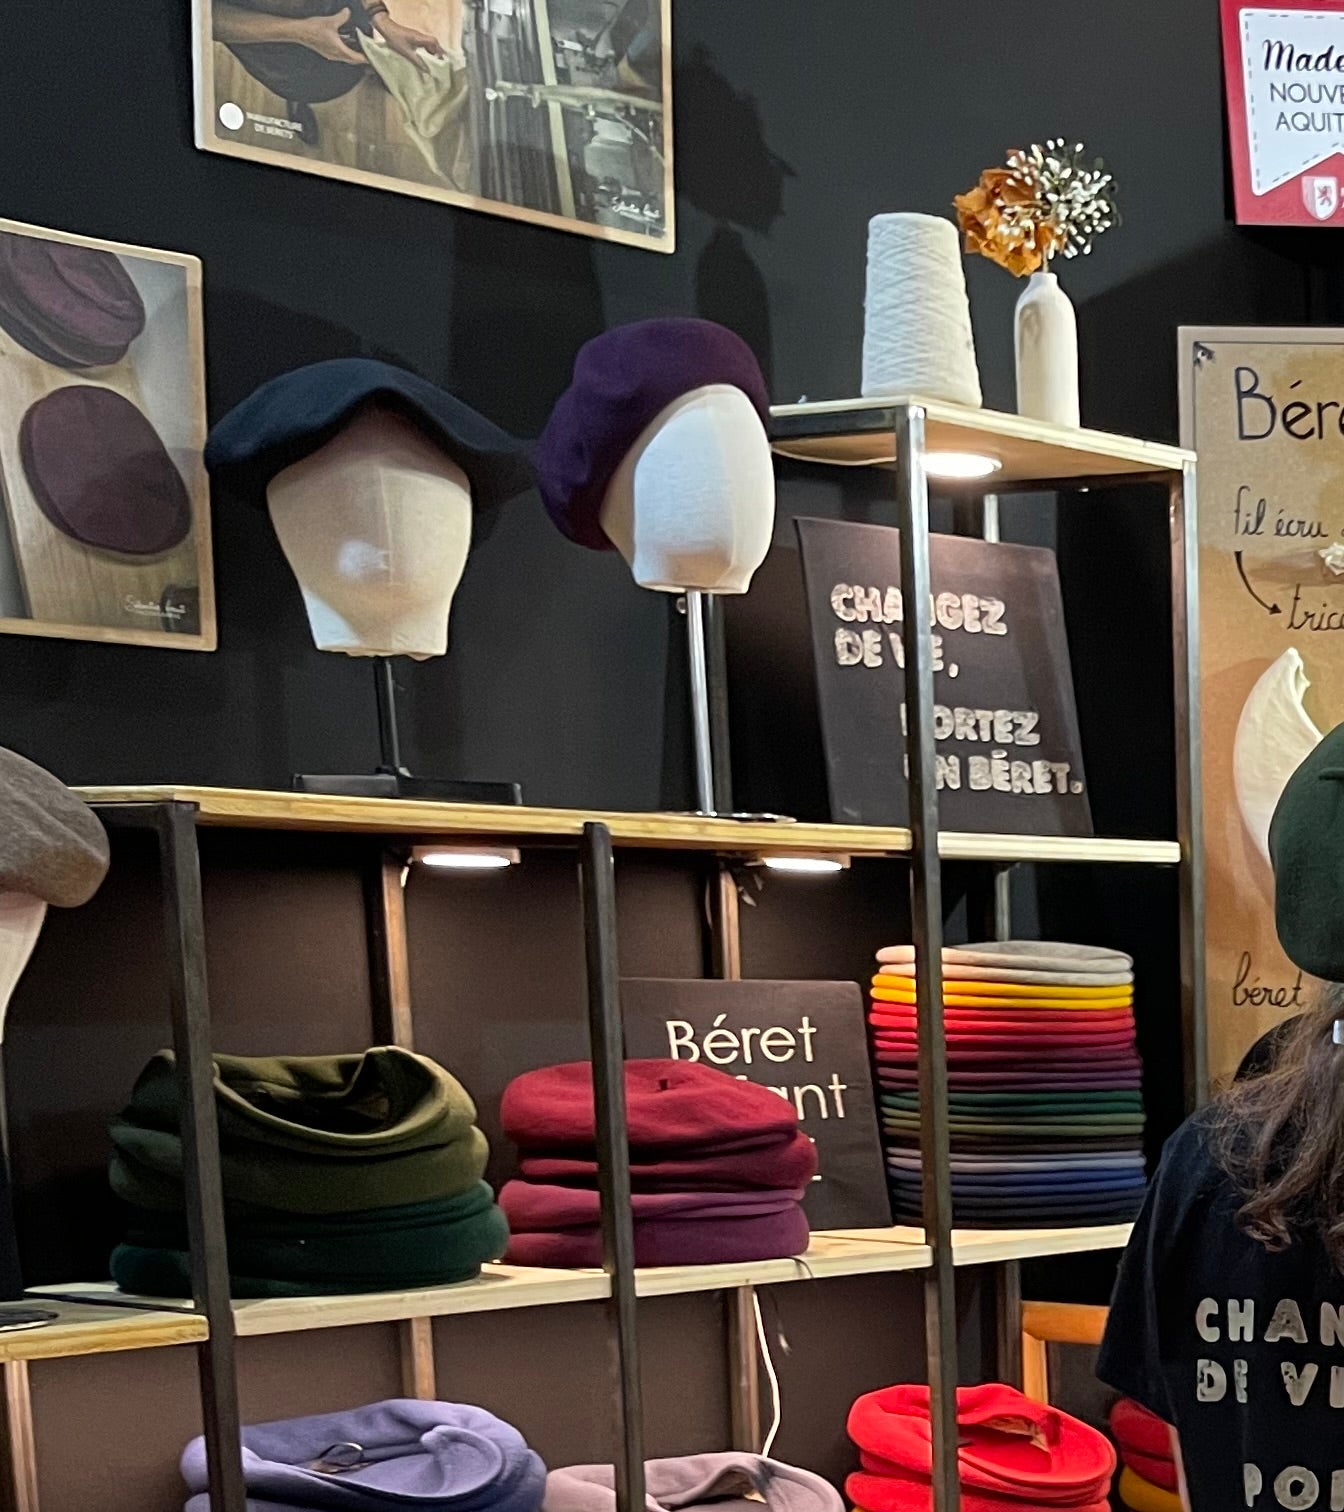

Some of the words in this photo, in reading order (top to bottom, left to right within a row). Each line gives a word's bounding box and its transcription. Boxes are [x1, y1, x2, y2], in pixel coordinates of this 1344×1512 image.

[1273, 508, 1329, 539] écru
[830, 583, 1008, 635] CHAGEZ
[834, 627, 883, 668] DE
[968, 749, 1084, 795] BÉRET.
[1232, 951, 1303, 1008] béret
[665, 1012, 818, 1065] Béret
